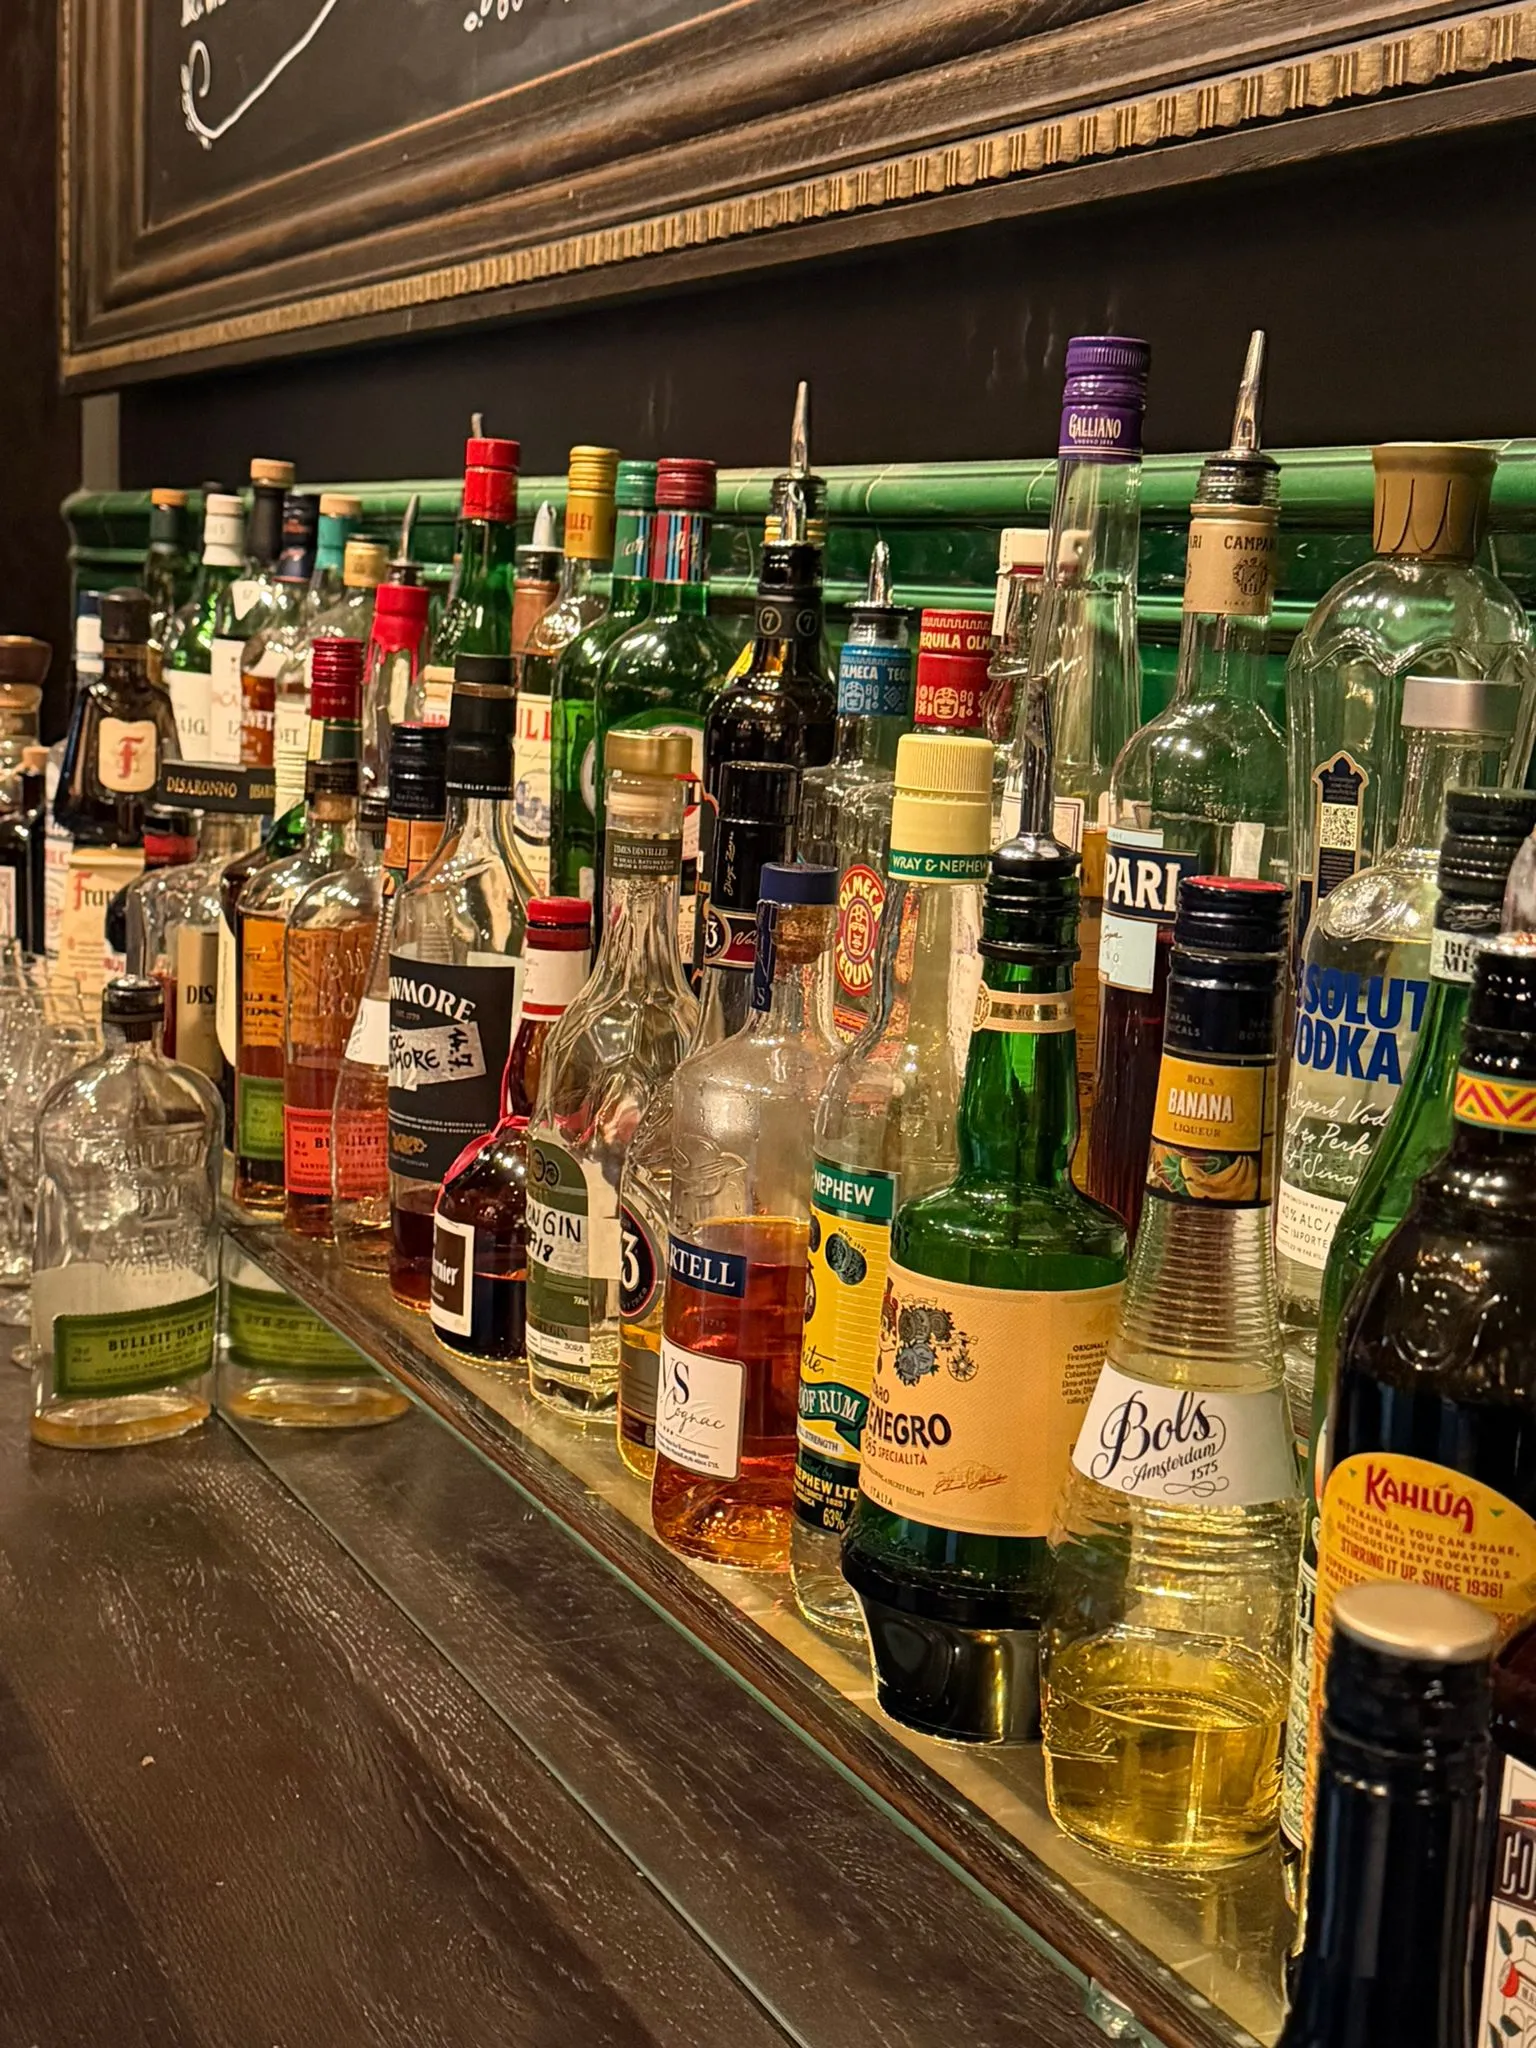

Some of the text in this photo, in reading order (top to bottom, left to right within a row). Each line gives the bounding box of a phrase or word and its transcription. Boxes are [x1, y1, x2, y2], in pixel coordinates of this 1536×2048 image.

[1068, 413, 1122, 439] GALLIANO
[919, 631, 961, 649] TEQUILA
[840, 664, 878, 680] OLMECA
[166, 776, 238, 798] DISARONNO
[893, 855, 922, 871] WRAY
[925, 859, 938, 872] &
[840, 875, 884, 922] OLMECA
[1104, 852, 1181, 912] PARI
[1297, 958, 1430, 1033] SOLUT
[1168, 1012, 1192, 1025] RAL
[1295, 1013, 1403, 1086] ODKA
[1187, 1074, 1215, 1087] BOLS
[1167, 1087, 1234, 1124] BANANA
[1290, 1081, 1347, 1120] Superb
[1173, 1121, 1222, 1138] LIQUEUR
[812, 1175, 875, 1208] NEPHEW
[542, 1210, 582, 1244] GIN
[108, 1329, 173, 1352] BULLEIT
[664, 1386, 726, 1434] Cognac
[818, 1389, 861, 1423] RUM
[1091, 1390, 1227, 1480] Bols
[795, 1462, 833, 1496] EPHEW
[834, 1483, 859, 1502] LTD
[1121, 1442, 1218, 1492] Amsterdam
[1190, 1458, 1219, 1482] 1575
[1364, 1463, 1475, 1534] KAHLÚA
[823, 1507, 846, 1531] 63%
[1336, 1519, 1397, 1556] DELICIOUSLY
[1399, 1548, 1430, 1566] EASY
[1367, 1522, 1383, 1536] OR
[1409, 1538, 1449, 1557] YOUR
[1449, 1548, 1478, 1563] WAY
[1482, 1554, 1501, 1567] TO
[1408, 1527, 1434, 1543] YOU
[1437, 1535, 1466, 1549] CAN
[1469, 1540, 1521, 1559] SHAKE,
[1339, 1536, 1384, 1570] STIRRING
[1386, 1557, 1399, 1576] IT
[1421, 1570, 1463, 1594] SINCE
[1465, 1577, 1504, 1600] 1936!
